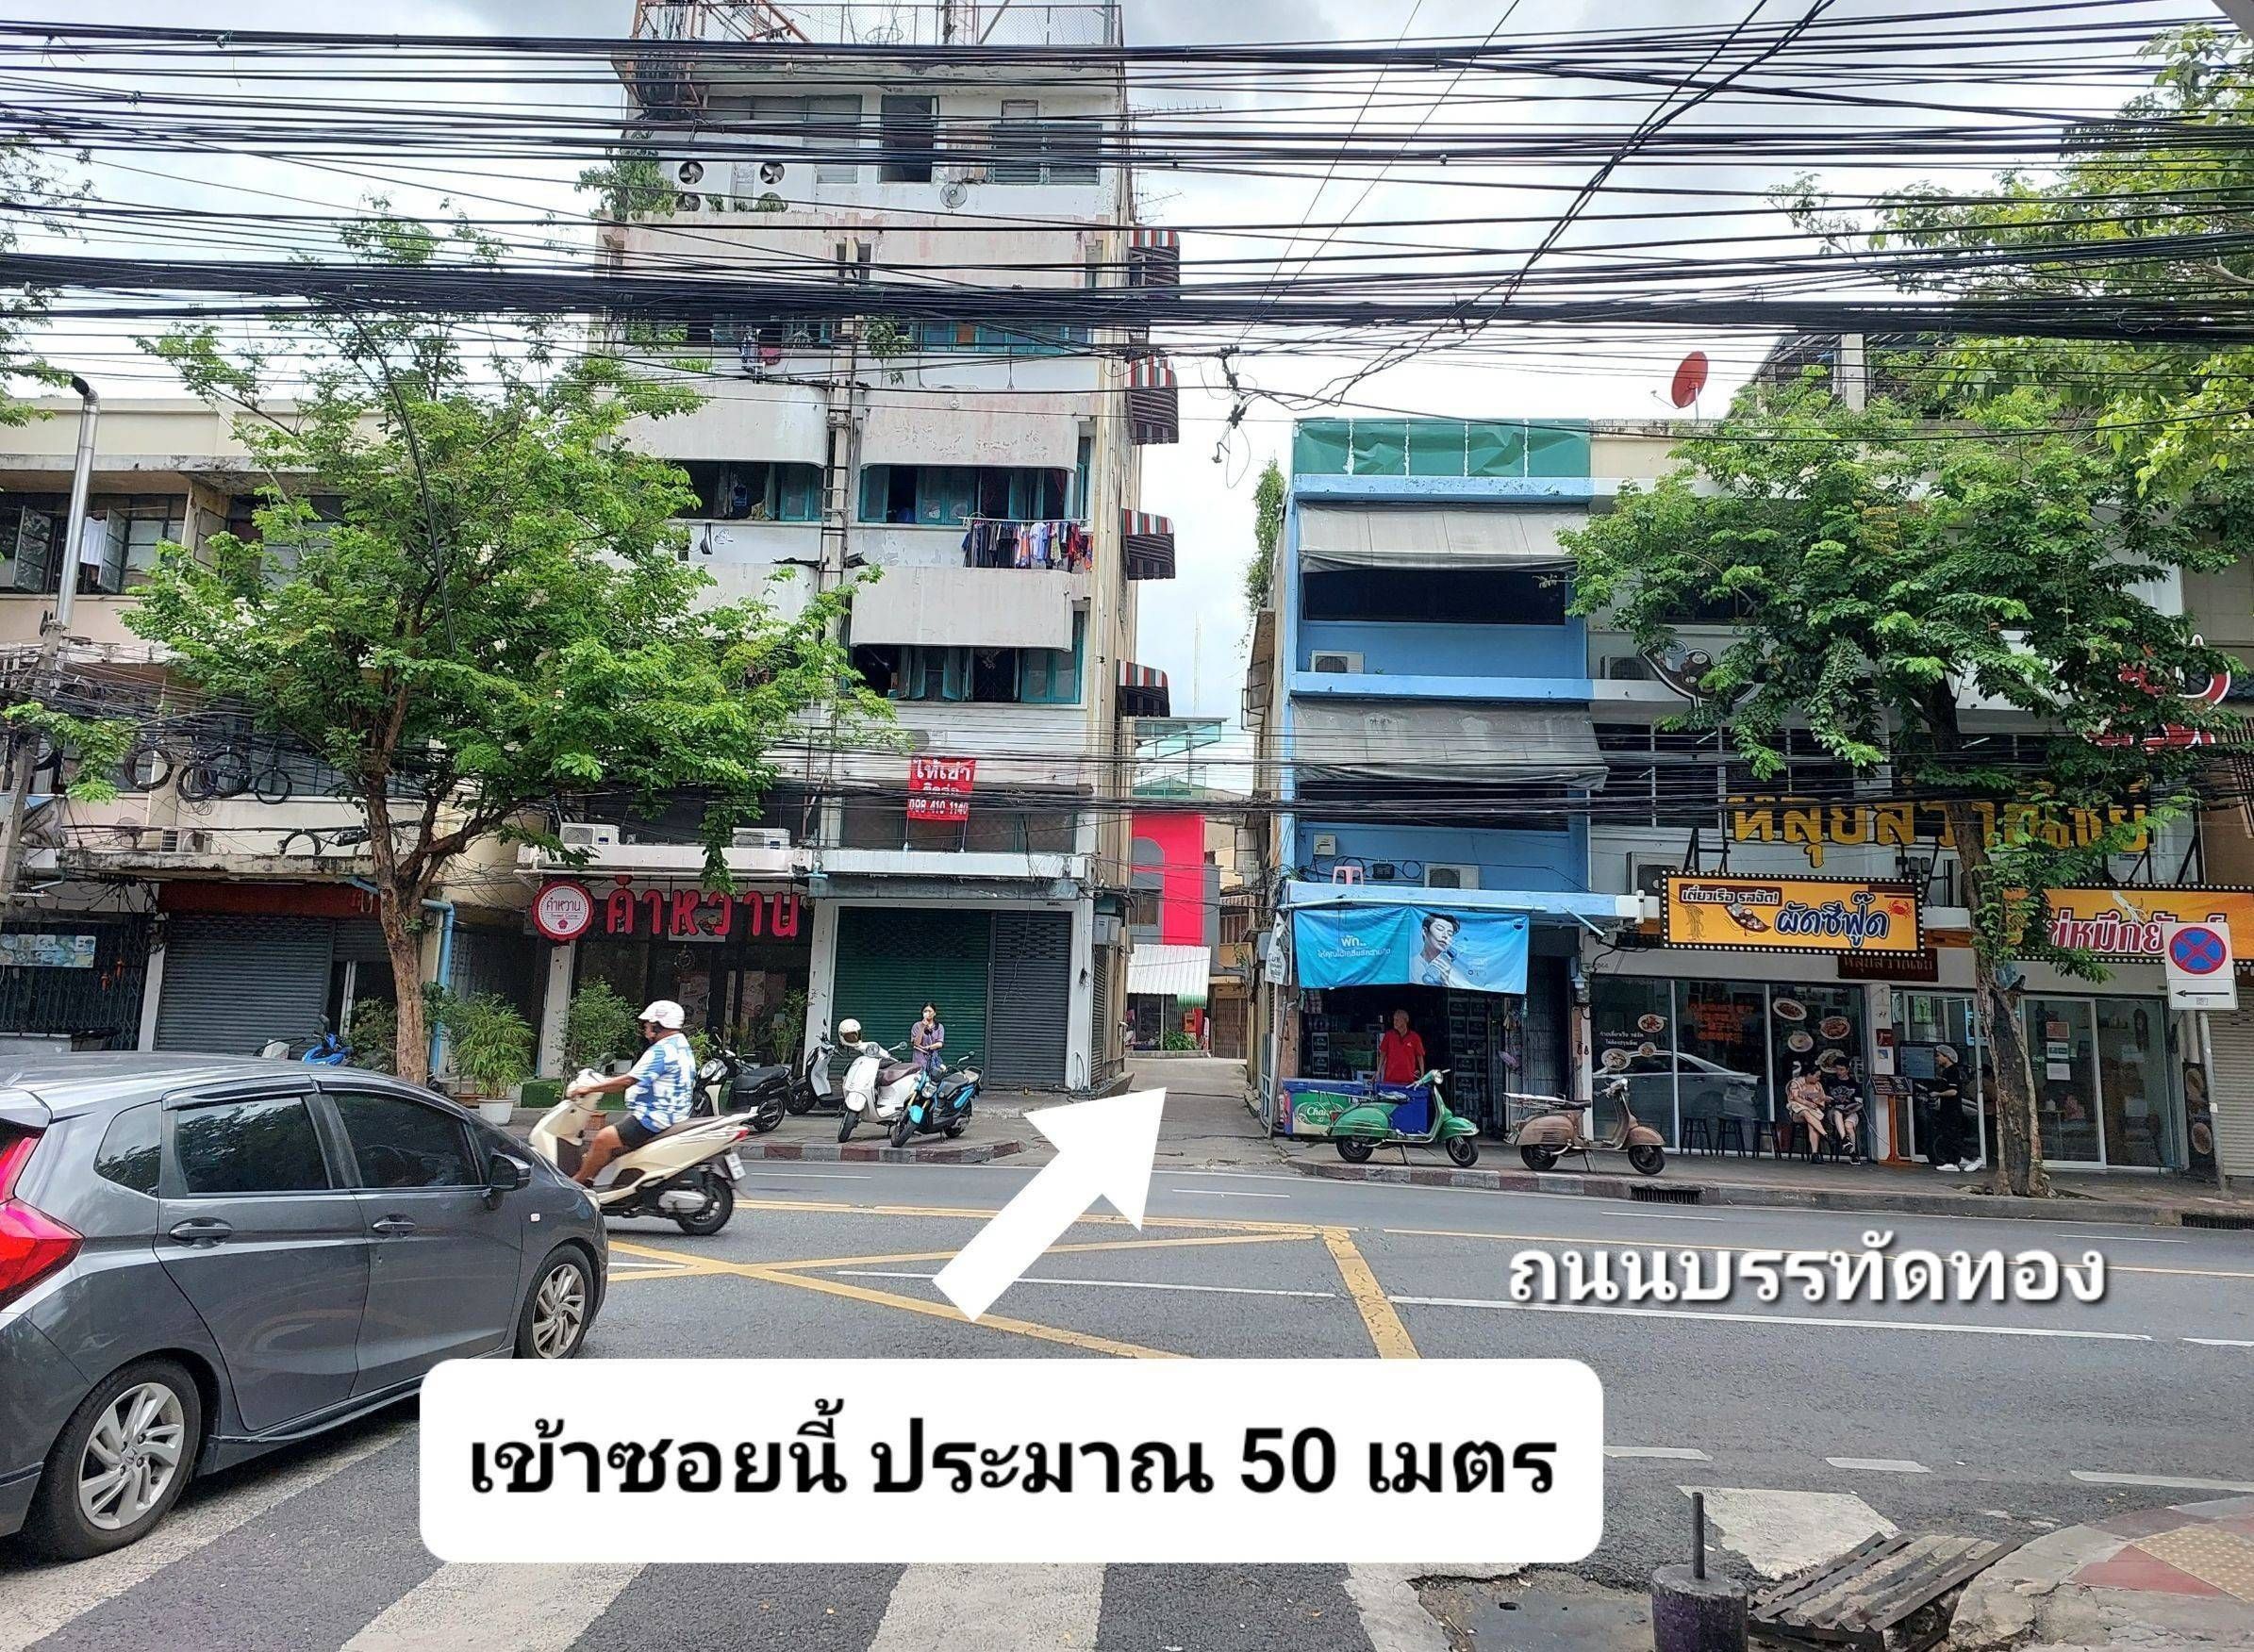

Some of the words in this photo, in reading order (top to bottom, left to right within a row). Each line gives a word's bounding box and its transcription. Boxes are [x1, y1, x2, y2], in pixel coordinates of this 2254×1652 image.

[1737, 889, 1780, 904] รสจัด!
[546, 897, 581, 912] คำหวาน
[605, 874, 801, 938] คำหวาน
